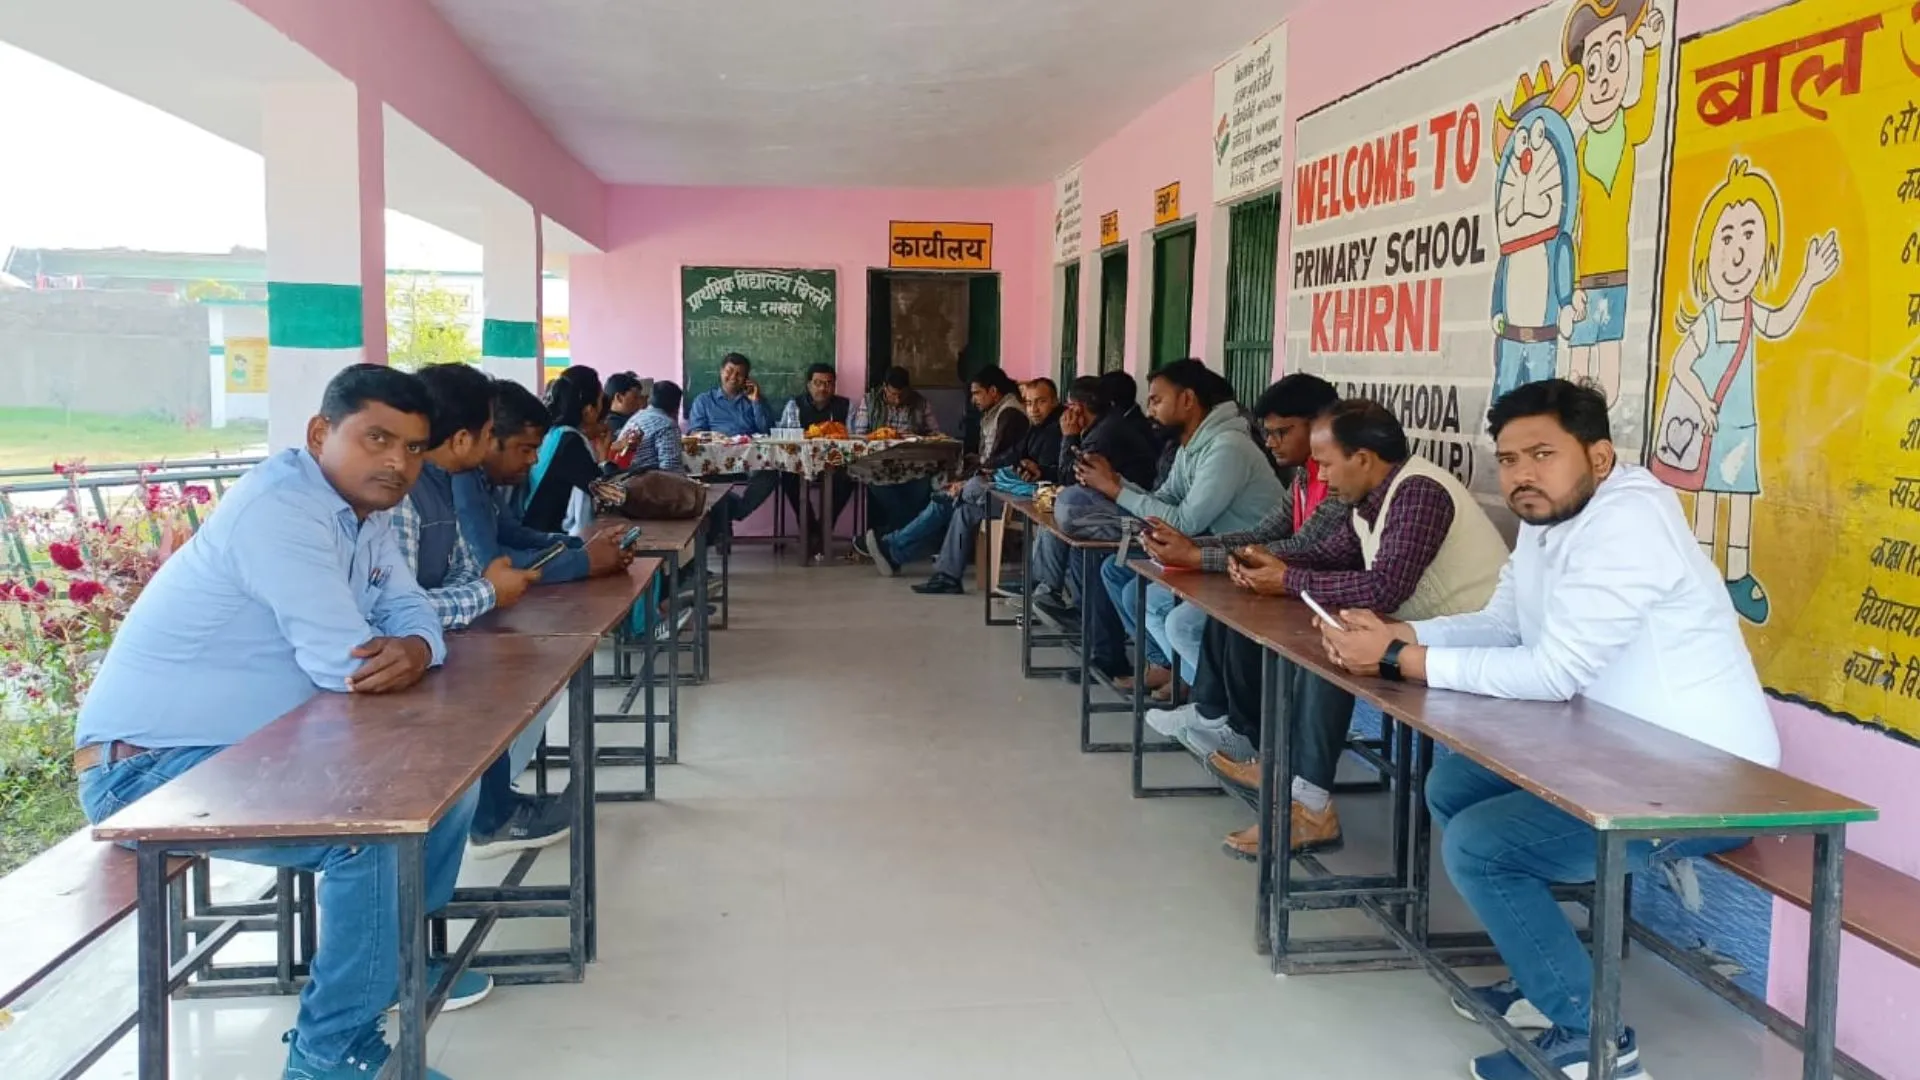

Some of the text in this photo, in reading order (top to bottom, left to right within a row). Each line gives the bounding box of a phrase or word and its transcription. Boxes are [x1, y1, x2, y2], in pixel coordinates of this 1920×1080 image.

[1695, 13, 1884, 127] बाल
[1296, 102, 1481, 226] WELCOME TO
[1294, 214, 1485, 290] PRIMARY SCHOOL
[686, 276, 735, 313] प्राथमिक
[734, 270, 793, 293] विद्यालय
[1309, 277, 1443, 353] KHIRNI
